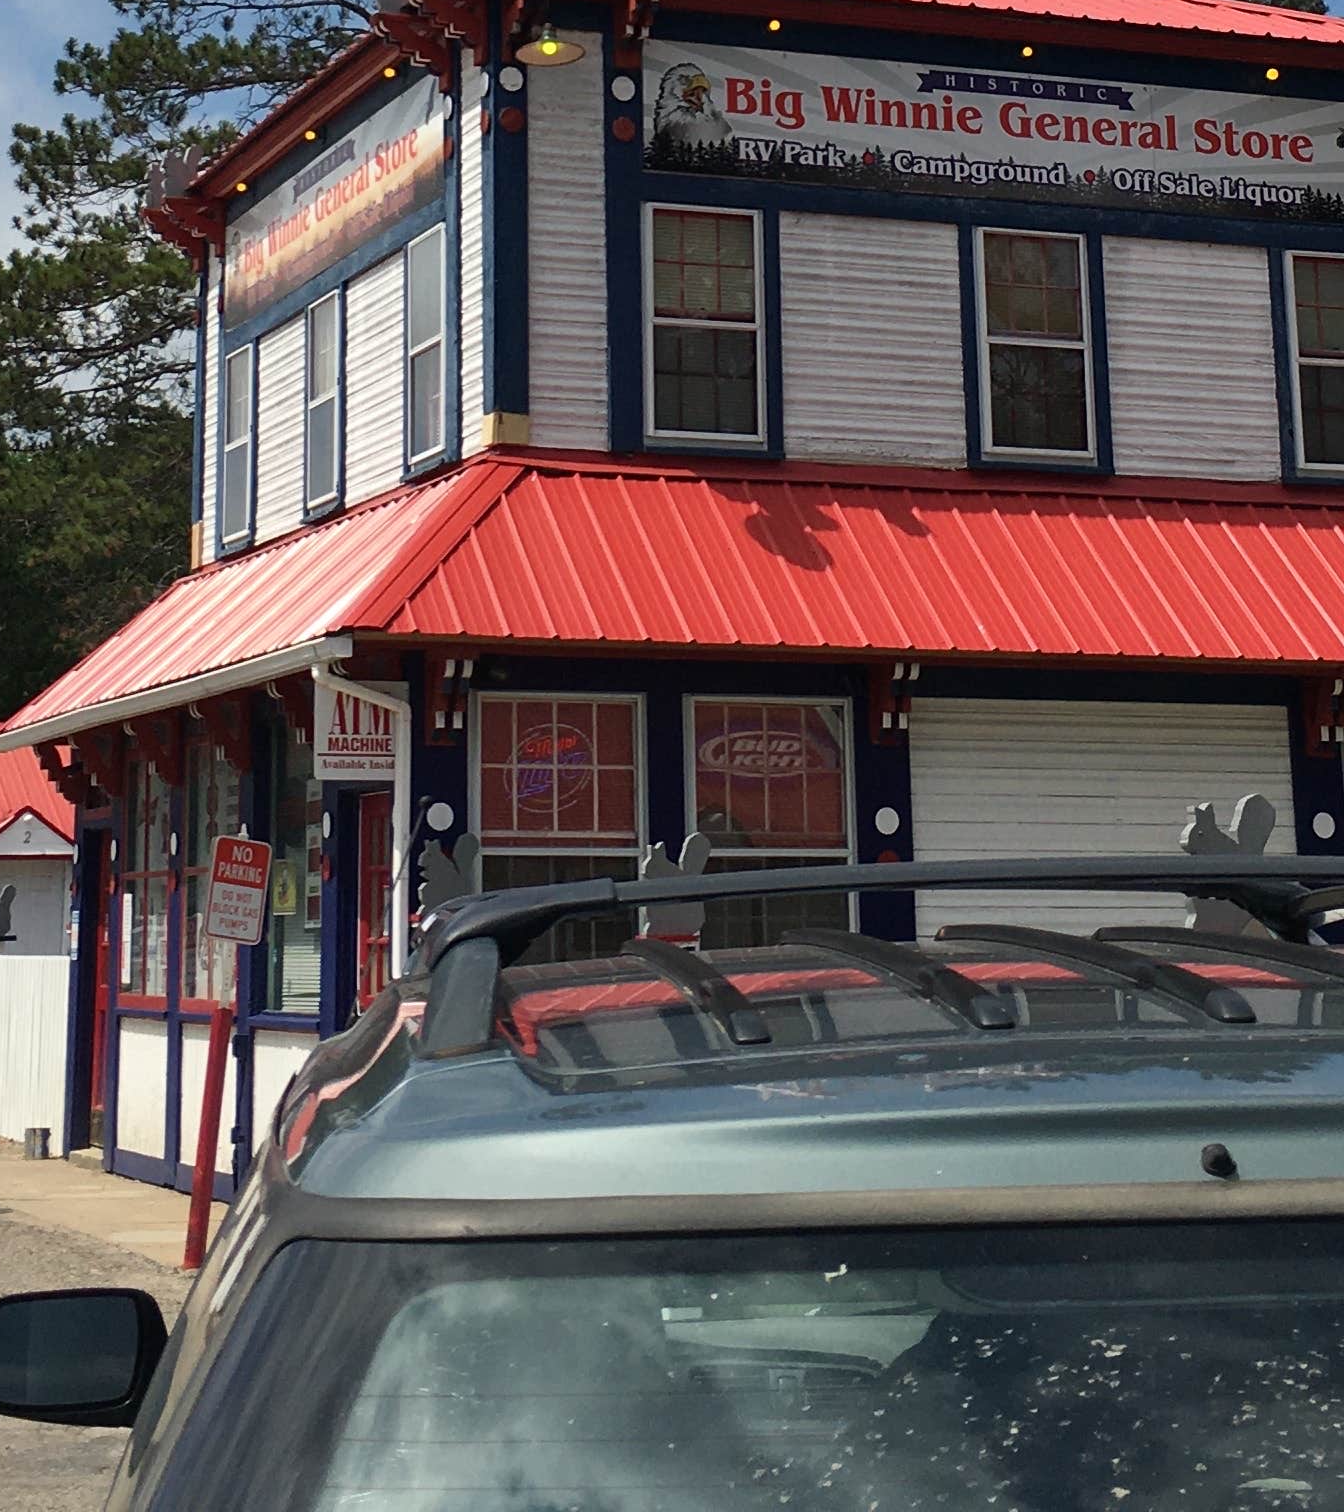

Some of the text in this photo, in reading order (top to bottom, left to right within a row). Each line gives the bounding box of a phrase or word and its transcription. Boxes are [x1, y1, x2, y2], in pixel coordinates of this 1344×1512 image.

[945, 74, 1108, 101] HISTORIC
[724, 77, 1315, 164] Big Winnie General Store
[738, 139, 1307, 207] RV Park Campground Off Sale Liquor
[243, 235, 264, 275] Big
[314, 151, 370, 222] General
[375, 127, 418, 182] Store
[327, 737, 393, 753] MACHINE
[732, 738, 801, 753] BUD
[321, 759, 395, 770] Available Insid
[23, 830, 32, 844] 2
[232, 846, 253, 863] NO
[217, 862, 263, 884] PARKING
[235, 891, 253, 904] NOT
[218, 916, 249, 932] PUMPS
